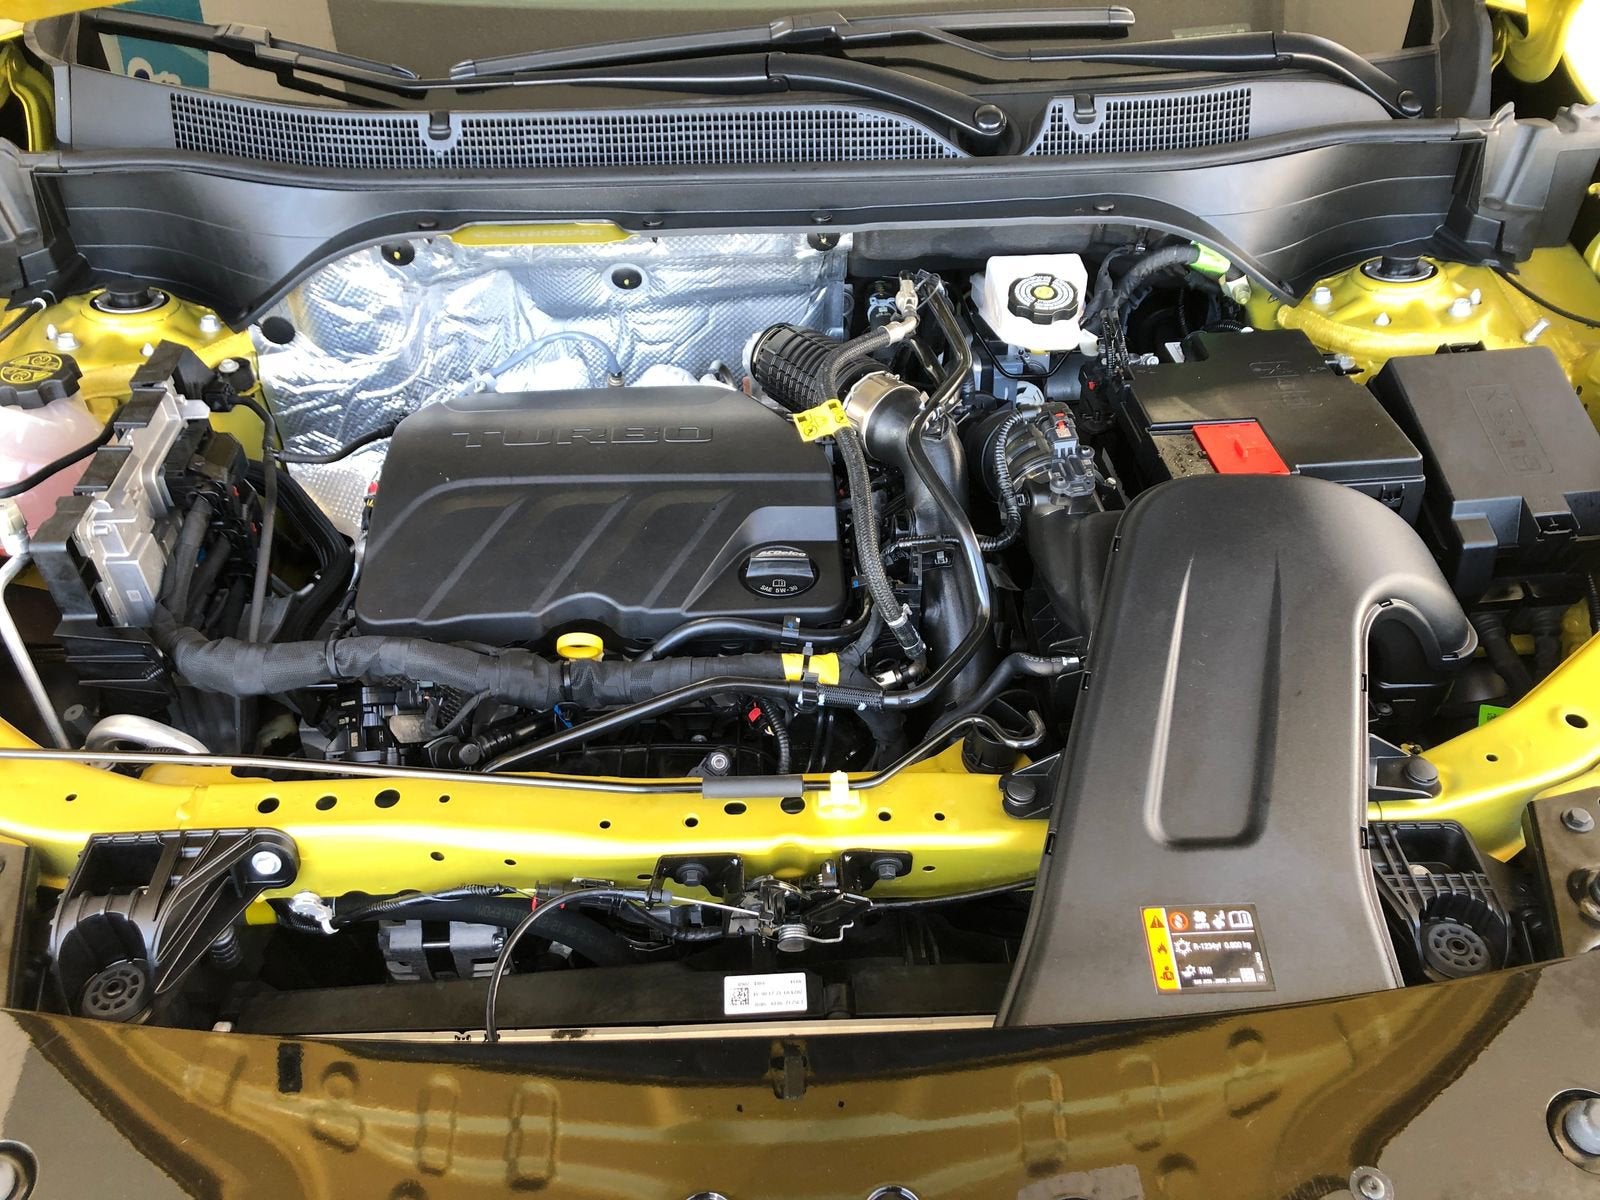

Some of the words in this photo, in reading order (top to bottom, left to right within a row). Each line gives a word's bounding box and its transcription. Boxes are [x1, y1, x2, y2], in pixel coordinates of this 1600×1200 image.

[450, 424, 713, 448] TURBO
[755, 550, 807, 558] ACDelco
[775, 585, 798, 593] 5W-30
